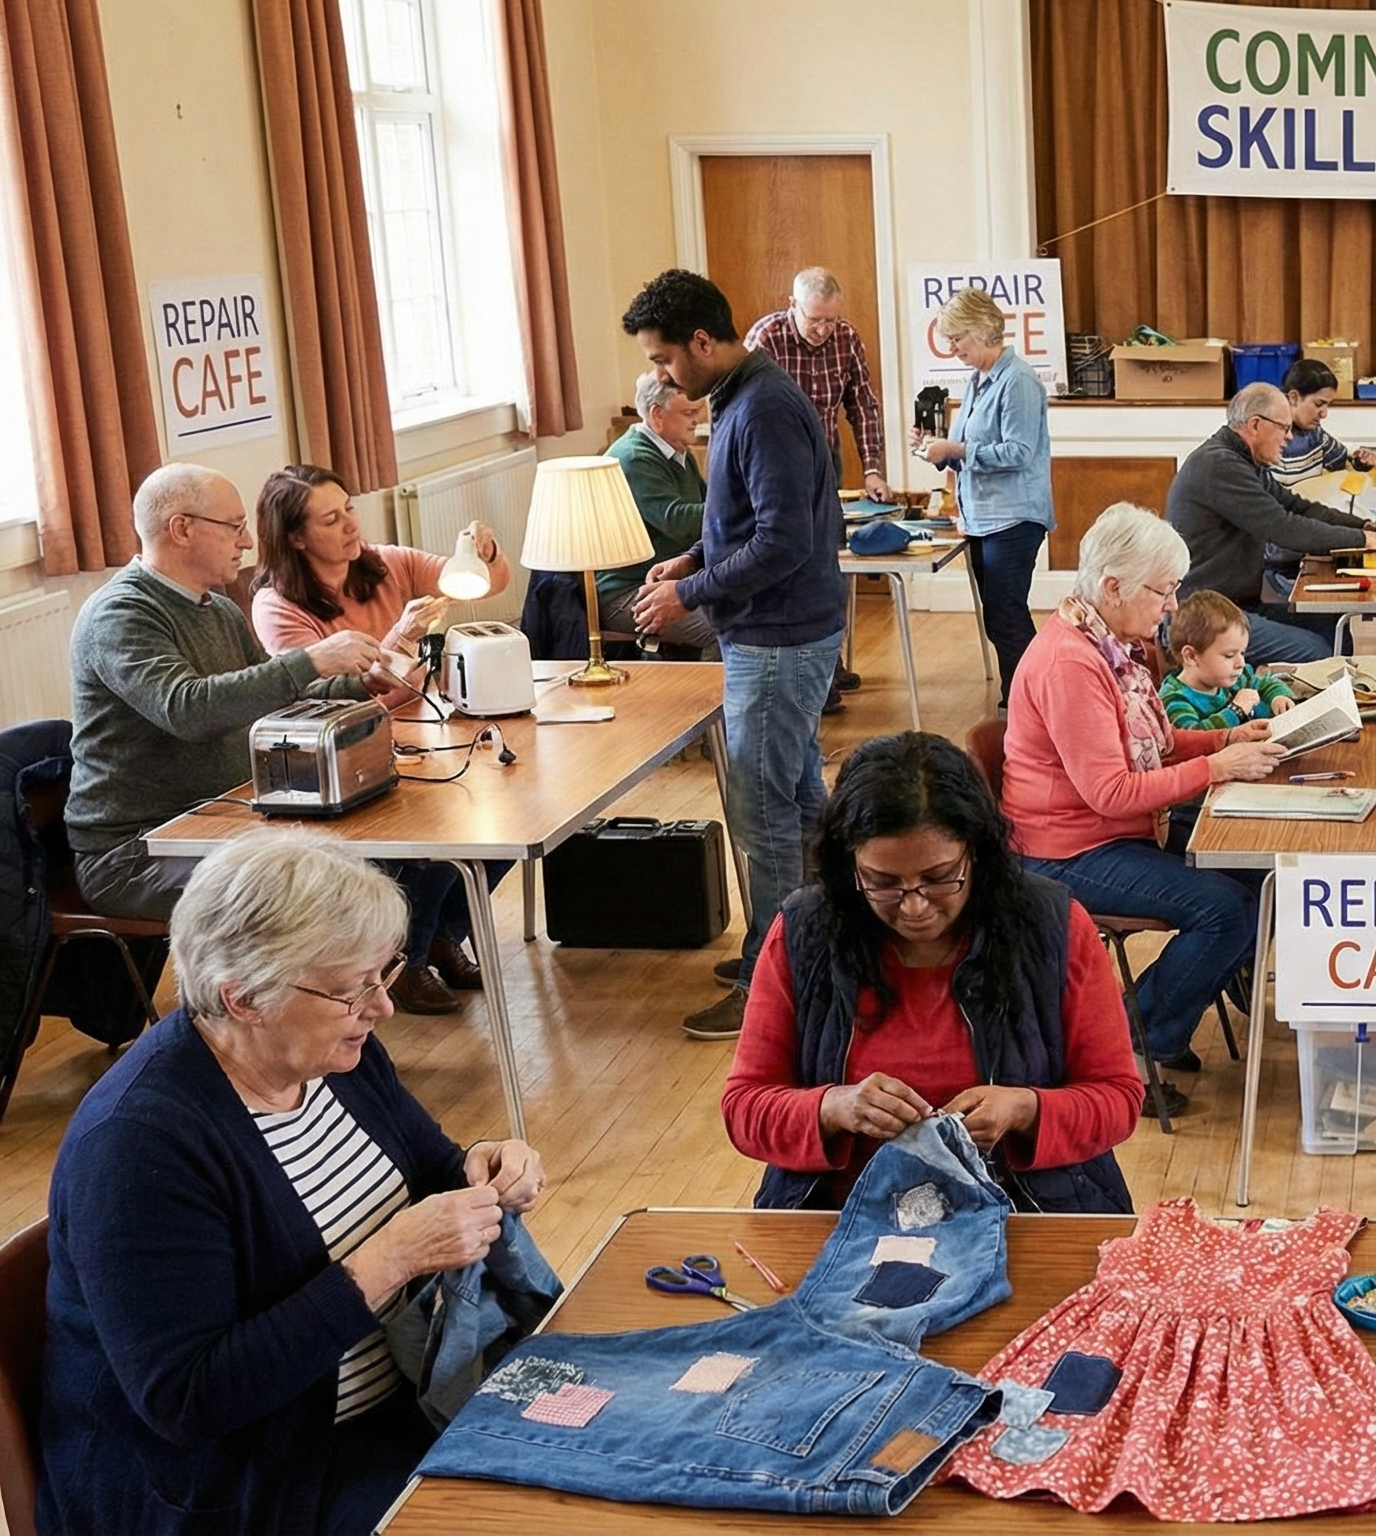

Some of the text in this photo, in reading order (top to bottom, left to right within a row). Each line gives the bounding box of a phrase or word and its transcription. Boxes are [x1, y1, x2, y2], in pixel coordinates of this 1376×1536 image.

[1197, 105, 1376, 172] SKILL
[162, 295, 260, 347] REPAIR
[927, 312, 1047, 359] CE
[172, 346, 267, 419] CAFE
